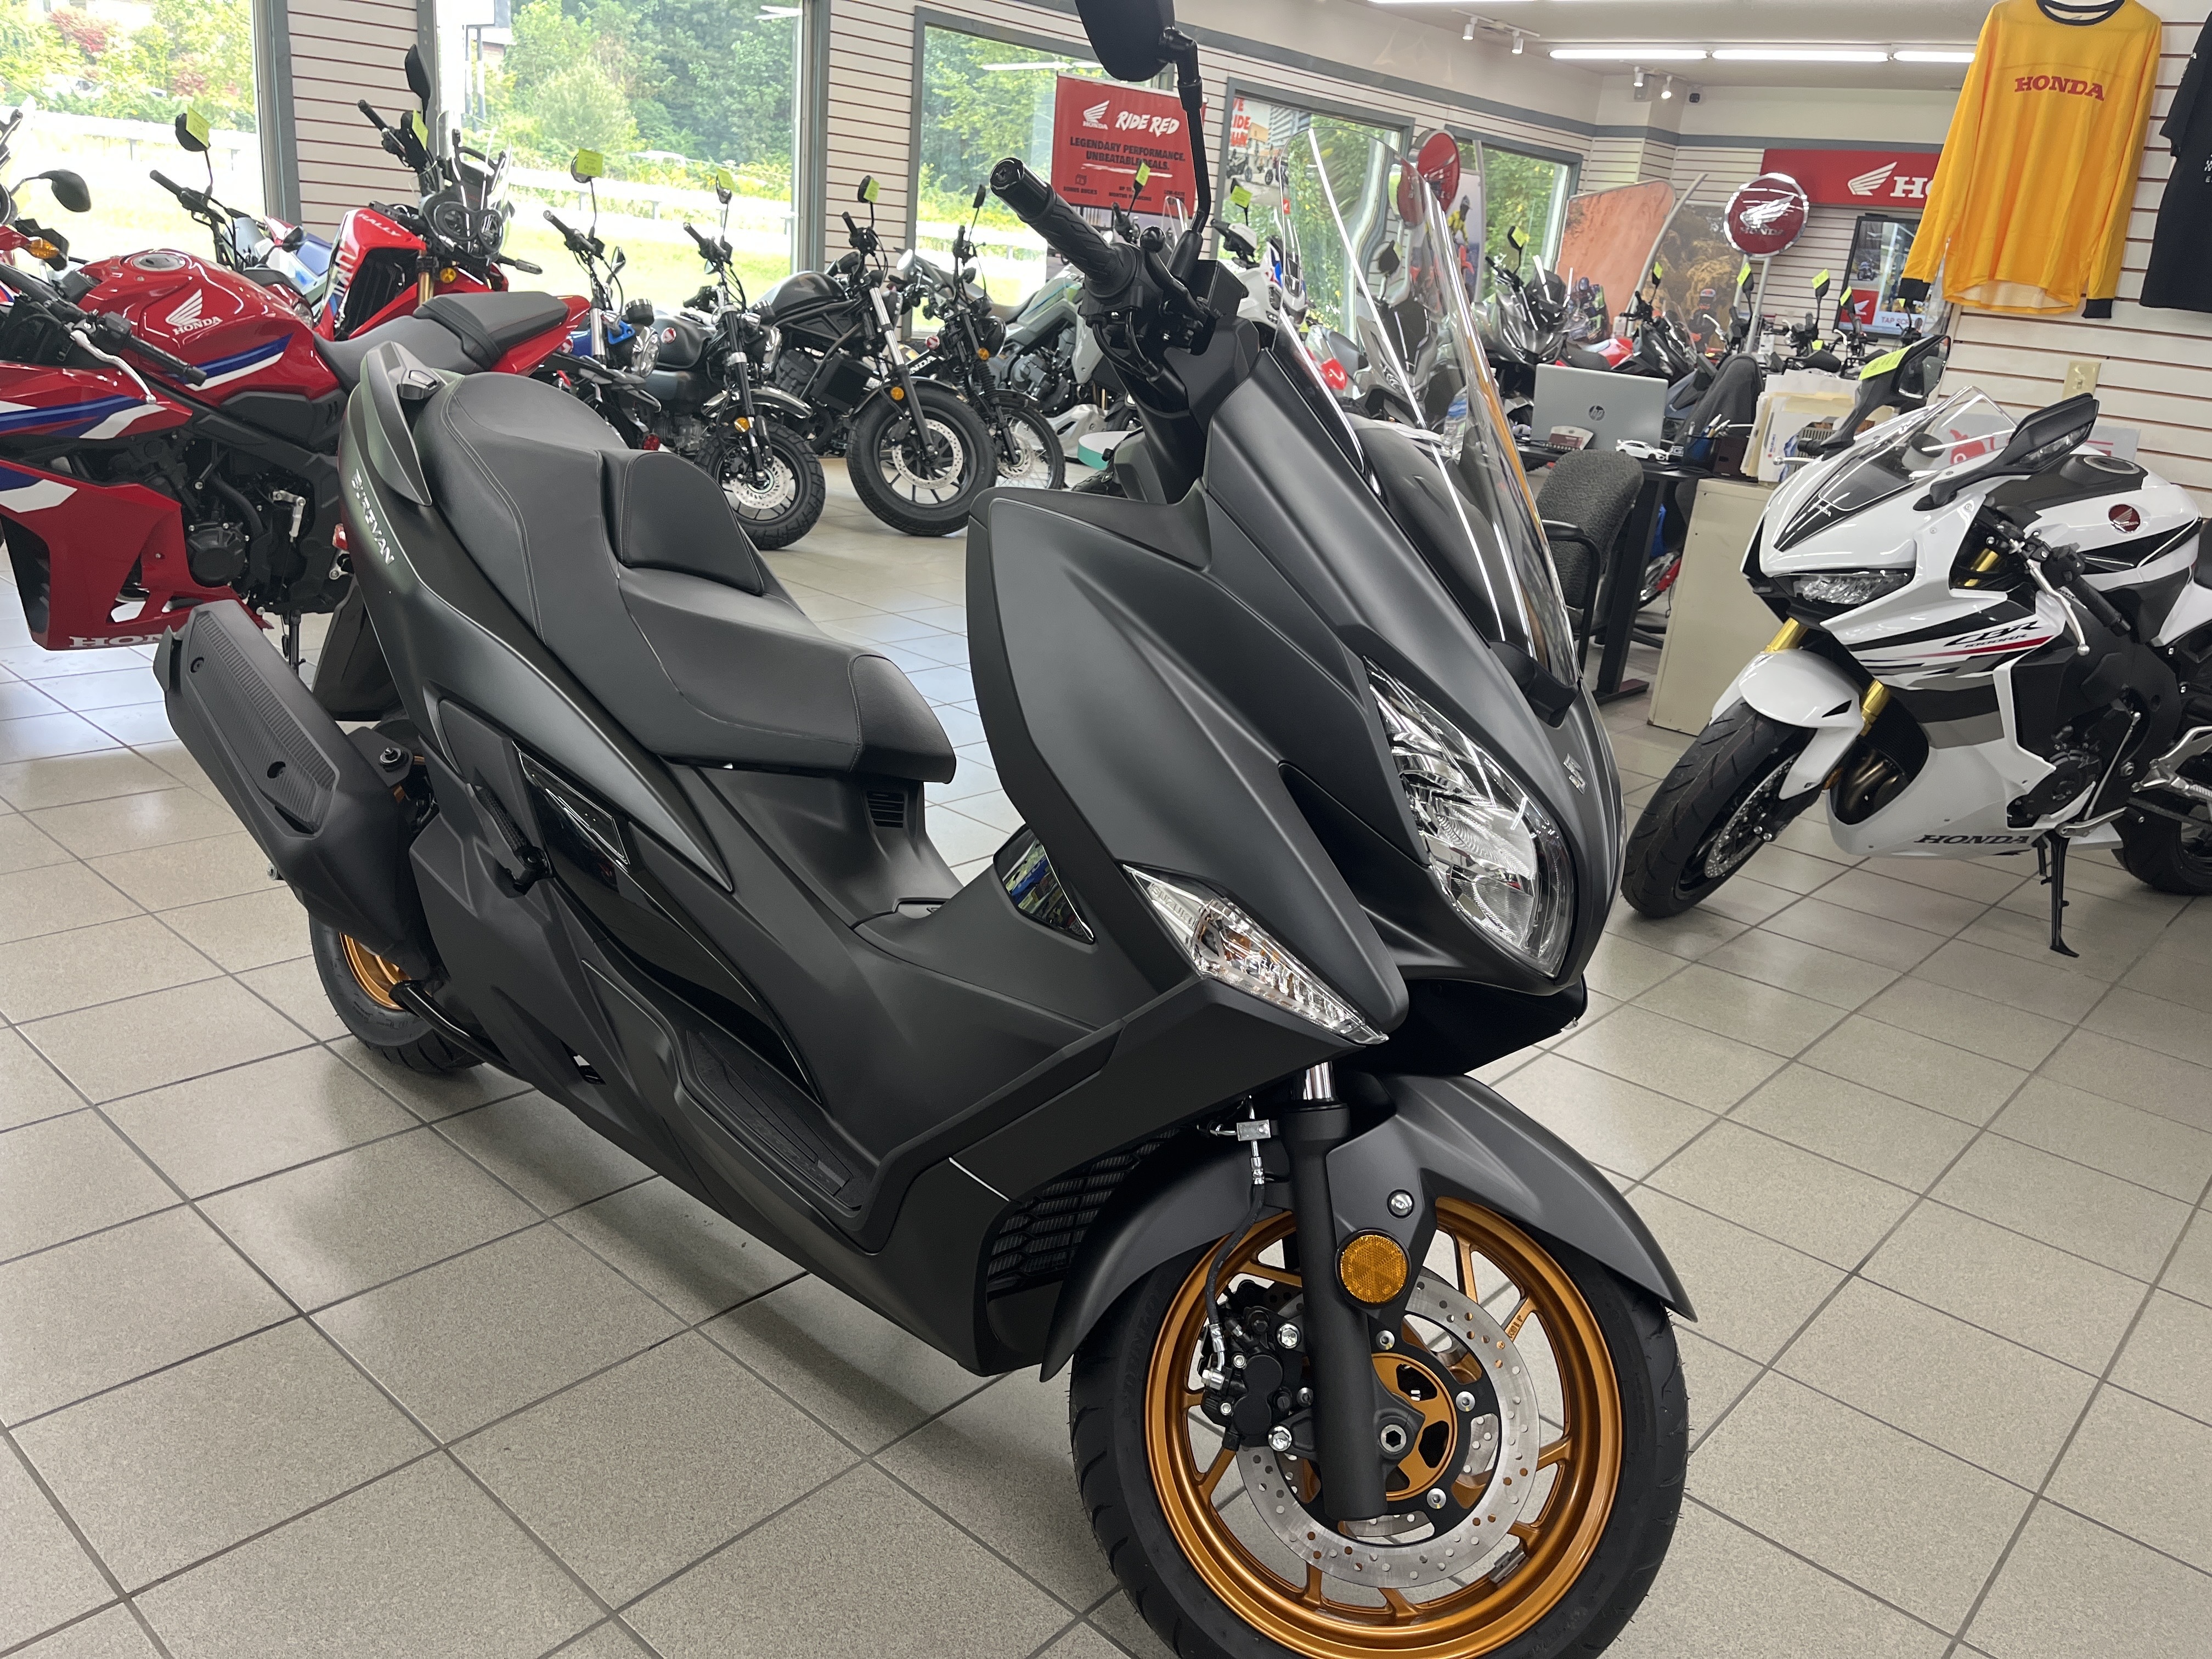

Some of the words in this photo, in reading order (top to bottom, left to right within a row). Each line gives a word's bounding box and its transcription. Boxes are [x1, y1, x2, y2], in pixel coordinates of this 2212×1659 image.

[2015, 75, 2104, 101] HONDA
[1115, 111, 1151, 131] RIDE
[1148, 116, 1180, 137] RED
[1070, 137, 1121, 153] LEGENDARY
[1123, 144, 1186, 161] PERFORMANCE.
[172, 316, 223, 335] HONDA
[909, 355, 937, 375] NDA
[1944, 620, 2044, 647] CBR
[1914, 834, 2030, 844] HONDA
[1152, 882, 1198, 930] SUZUKI
